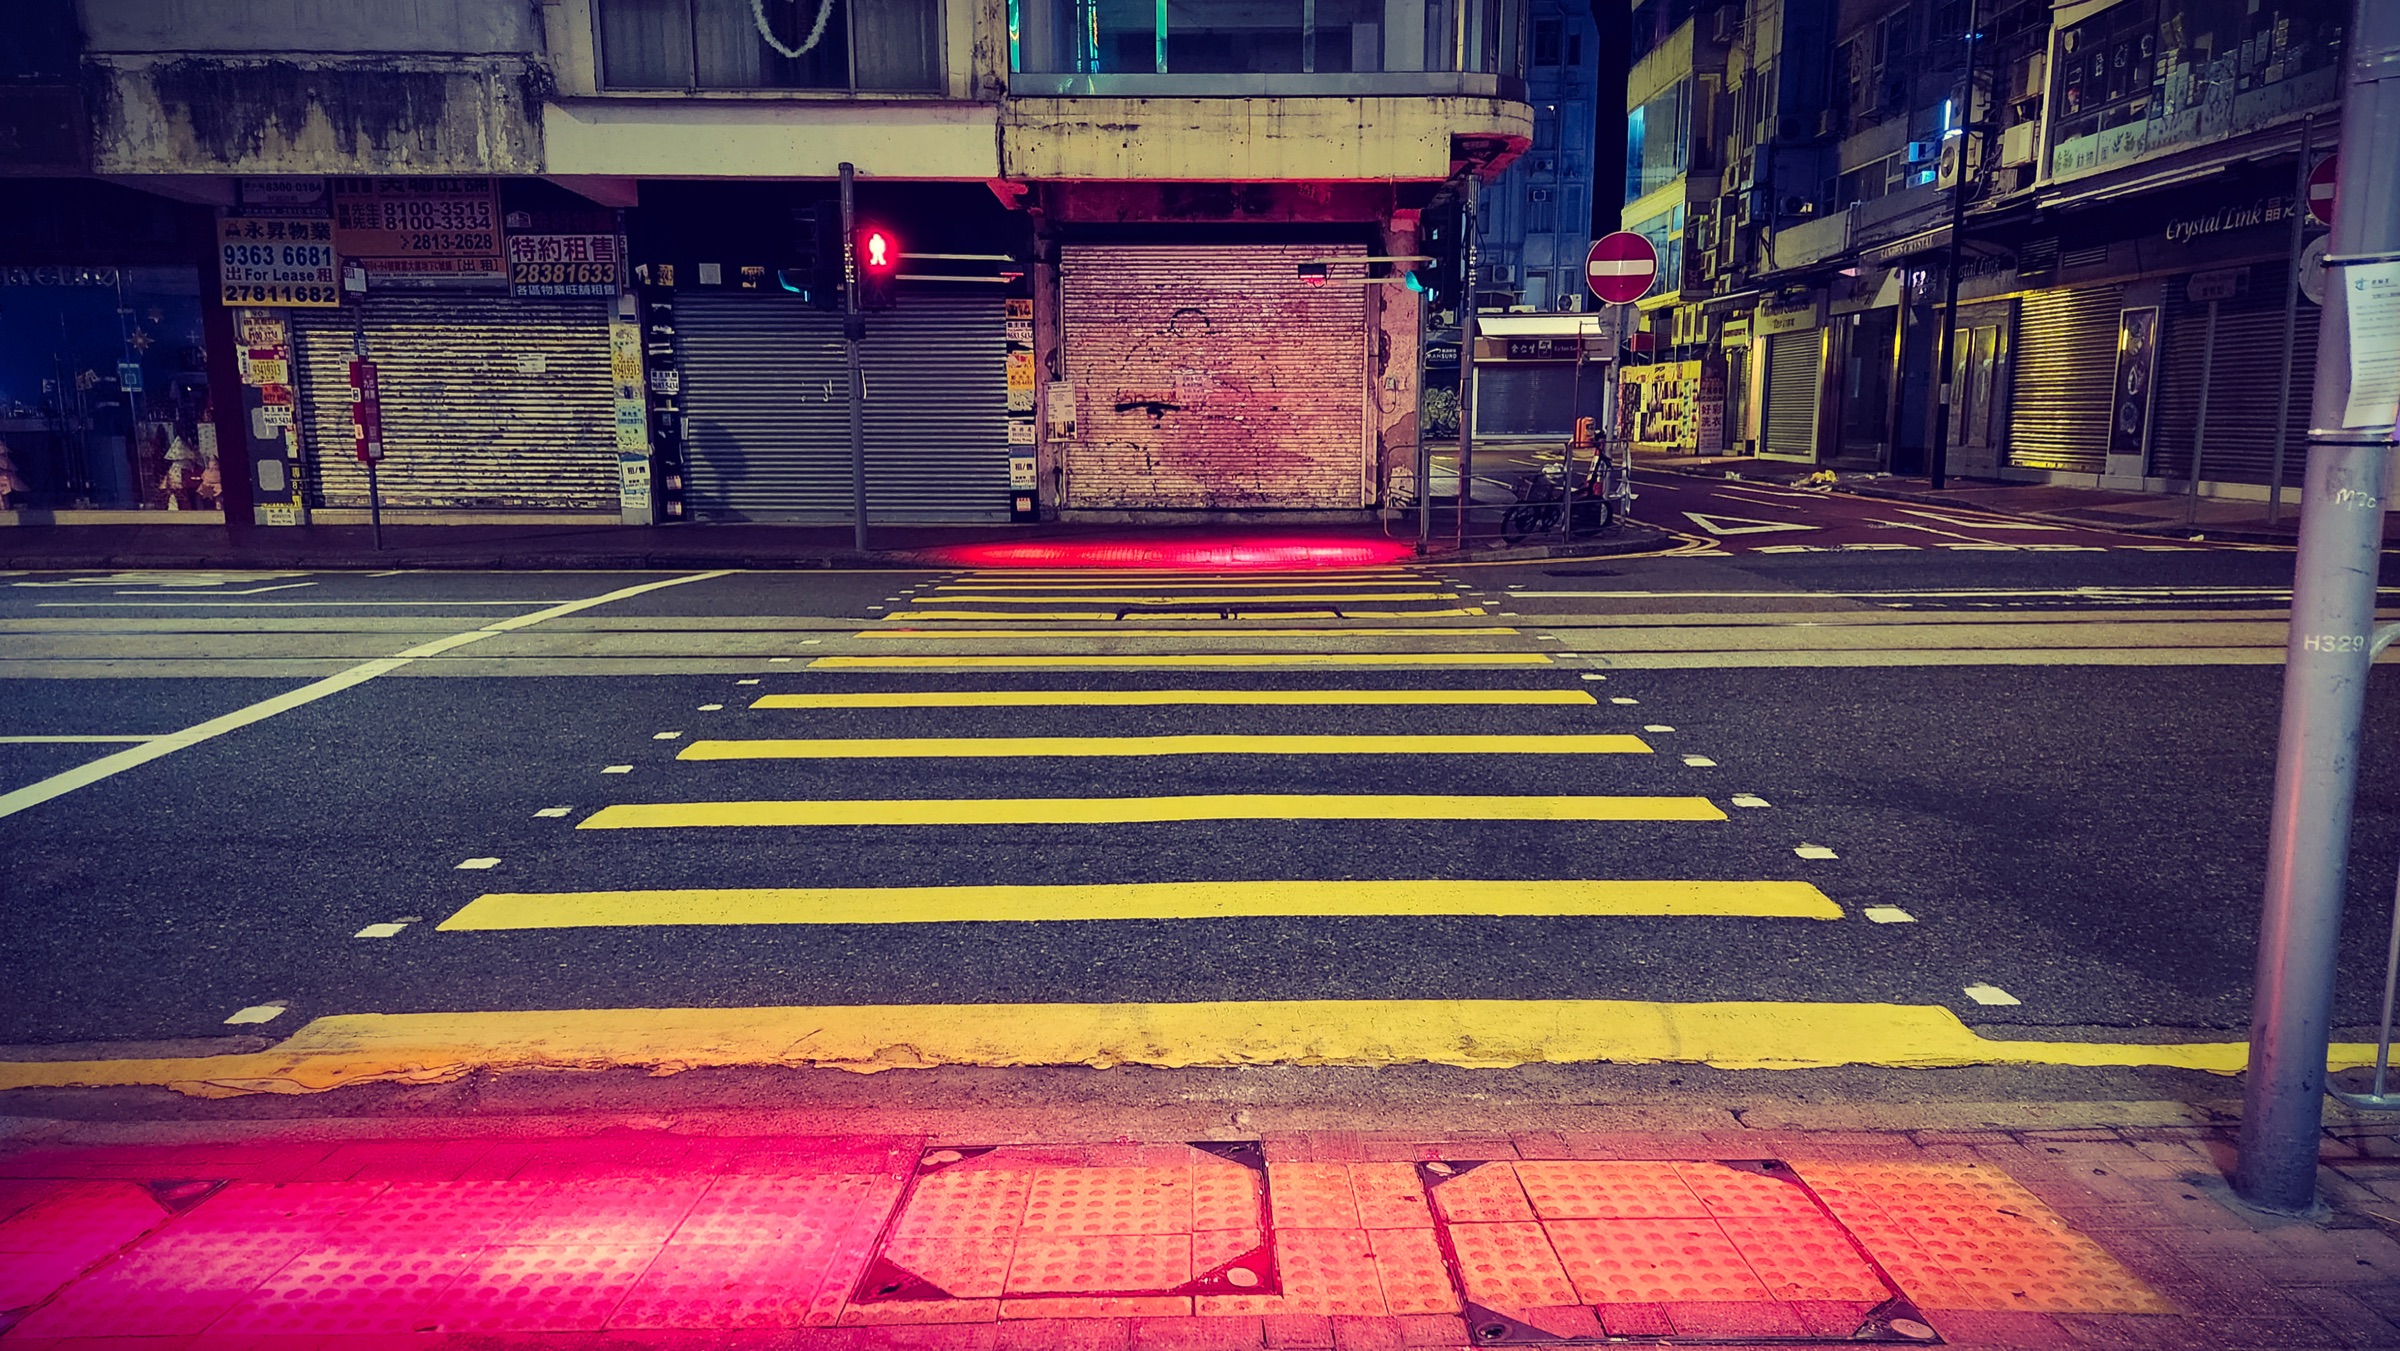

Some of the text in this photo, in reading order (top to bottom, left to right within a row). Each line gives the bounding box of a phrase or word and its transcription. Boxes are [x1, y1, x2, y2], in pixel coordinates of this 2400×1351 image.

[383, 201, 491, 216] 8100-3515
[385, 216, 492, 231] 8100-3334
[2165, 205, 2227, 244] Crystal
[2222, 197, 2264, 231] Link
[244, 221, 332, 241] 永昇物業
[411, 234, 494, 250] 2813-2628
[512, 236, 615, 263] 特約租售
[224, 245, 331, 266] 9363 6681
[226, 267, 242, 282] 出
[245, 268, 270, 282] For
[273, 269, 316, 282] Lease
[316, 268, 335, 283] 租
[515, 263, 616, 284] 28381633
[224, 285, 337, 303] 27811682
[2303, 634, 2365, 653] H329
